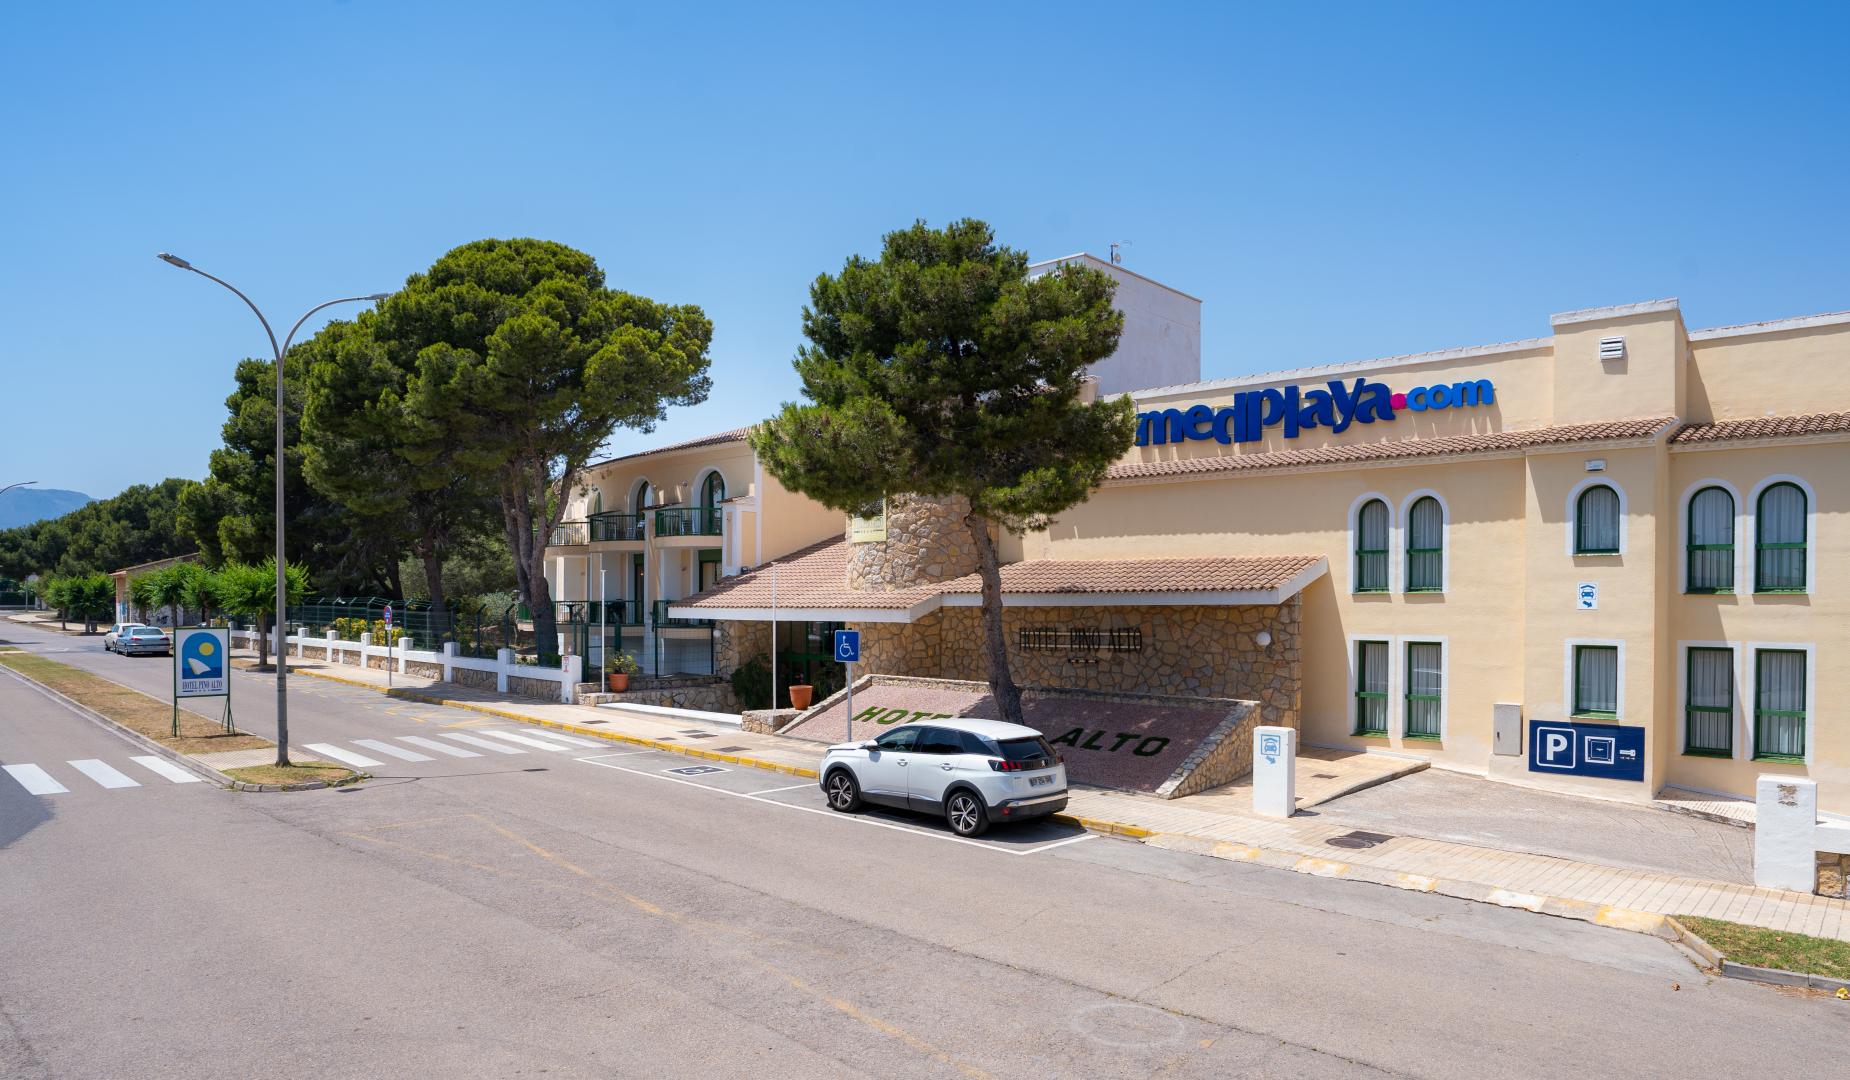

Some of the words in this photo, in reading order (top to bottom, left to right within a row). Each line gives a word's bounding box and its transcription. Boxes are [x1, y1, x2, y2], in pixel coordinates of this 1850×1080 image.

[182, 681, 198, 690] HOTEL
[211, 679, 223, 688] ALTO
[1049, 727, 1170, 757] ALTO
[1546, 733, 1568, 761] P
